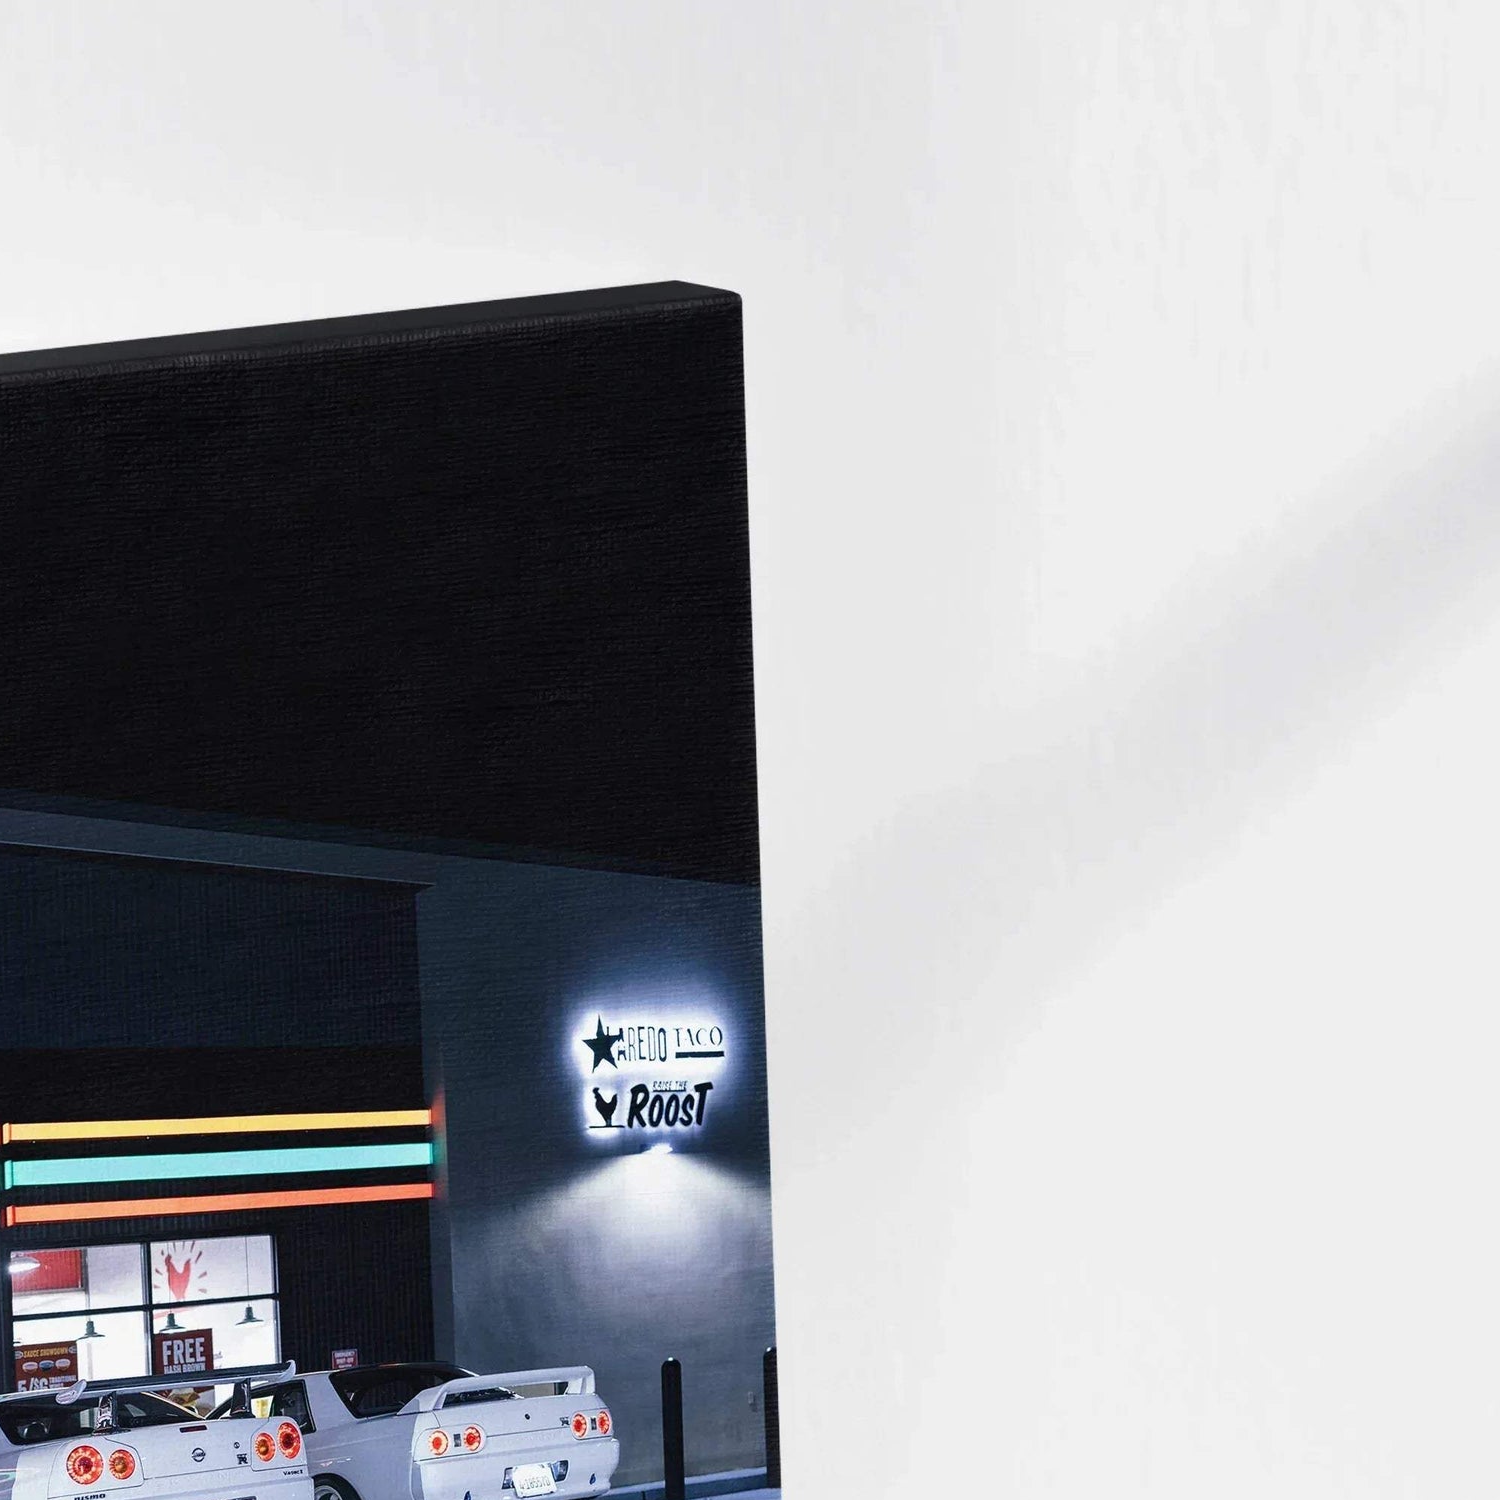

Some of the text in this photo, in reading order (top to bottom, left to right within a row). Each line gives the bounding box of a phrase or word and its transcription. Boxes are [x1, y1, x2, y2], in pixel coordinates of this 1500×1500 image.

[606, 1026, 723, 1062] AREDO TACO
[627, 1081, 713, 1128] ROOST
[163, 1337, 206, 1365] FREE
